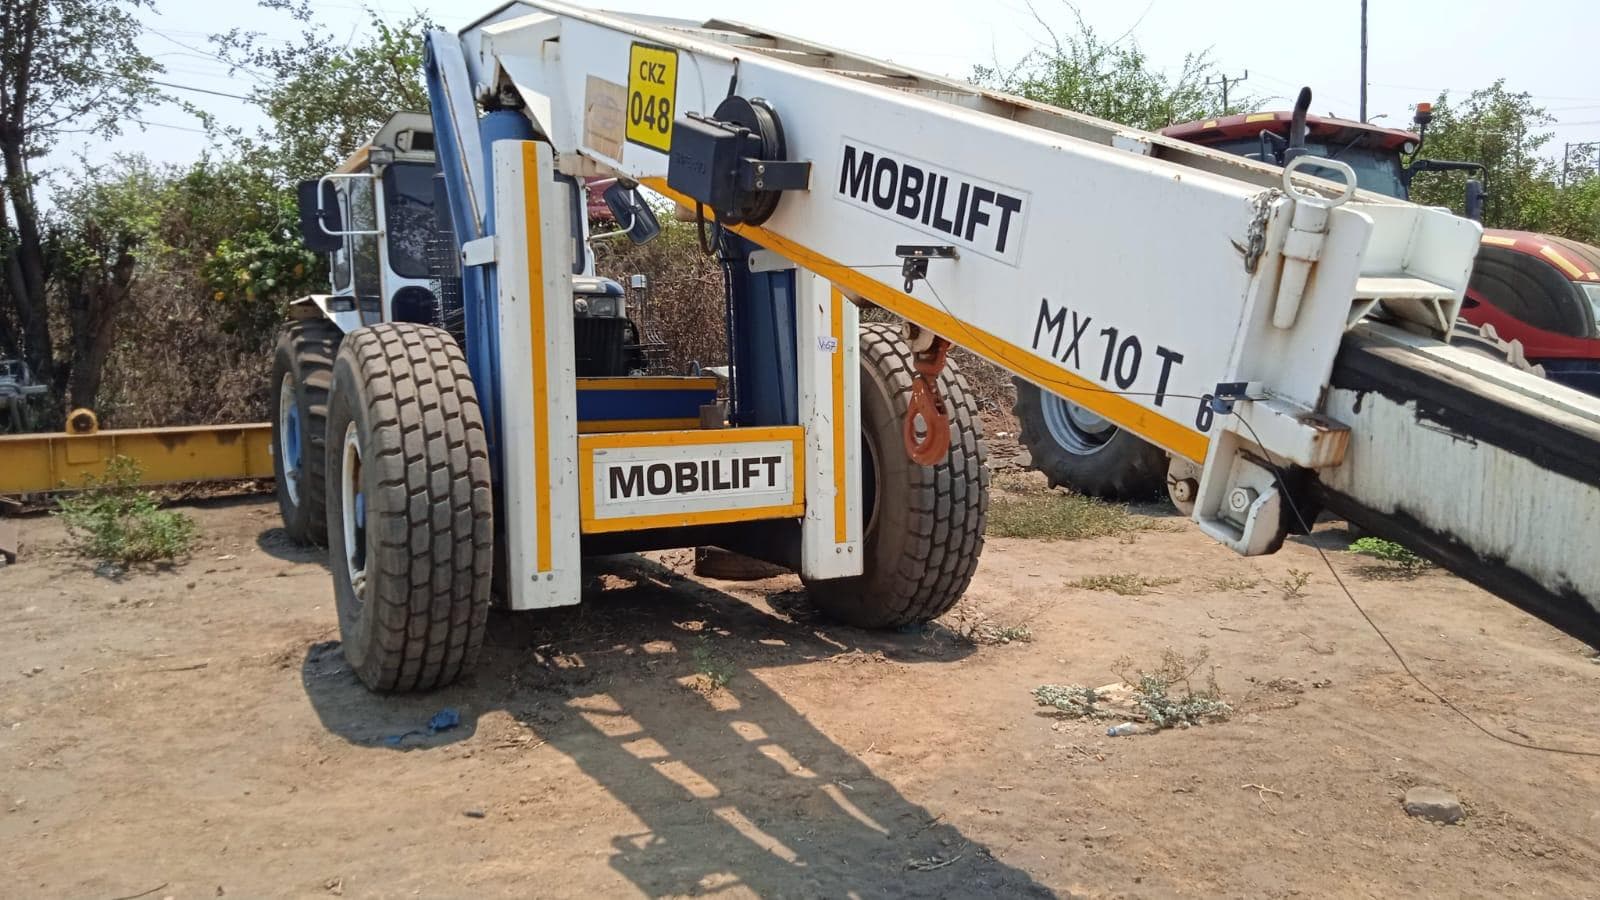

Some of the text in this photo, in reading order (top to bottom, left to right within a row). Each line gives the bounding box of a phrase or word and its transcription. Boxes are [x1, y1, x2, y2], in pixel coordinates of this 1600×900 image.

[639, 61, 666, 84] CKZ
[630, 91, 670, 134] 048
[838, 144, 1023, 254] MOBILIFT
[1032, 298, 1184, 407] MX 10 T
[1196, 393, 1214, 432] 6
[609, 456, 782, 499] MOBILIFT
